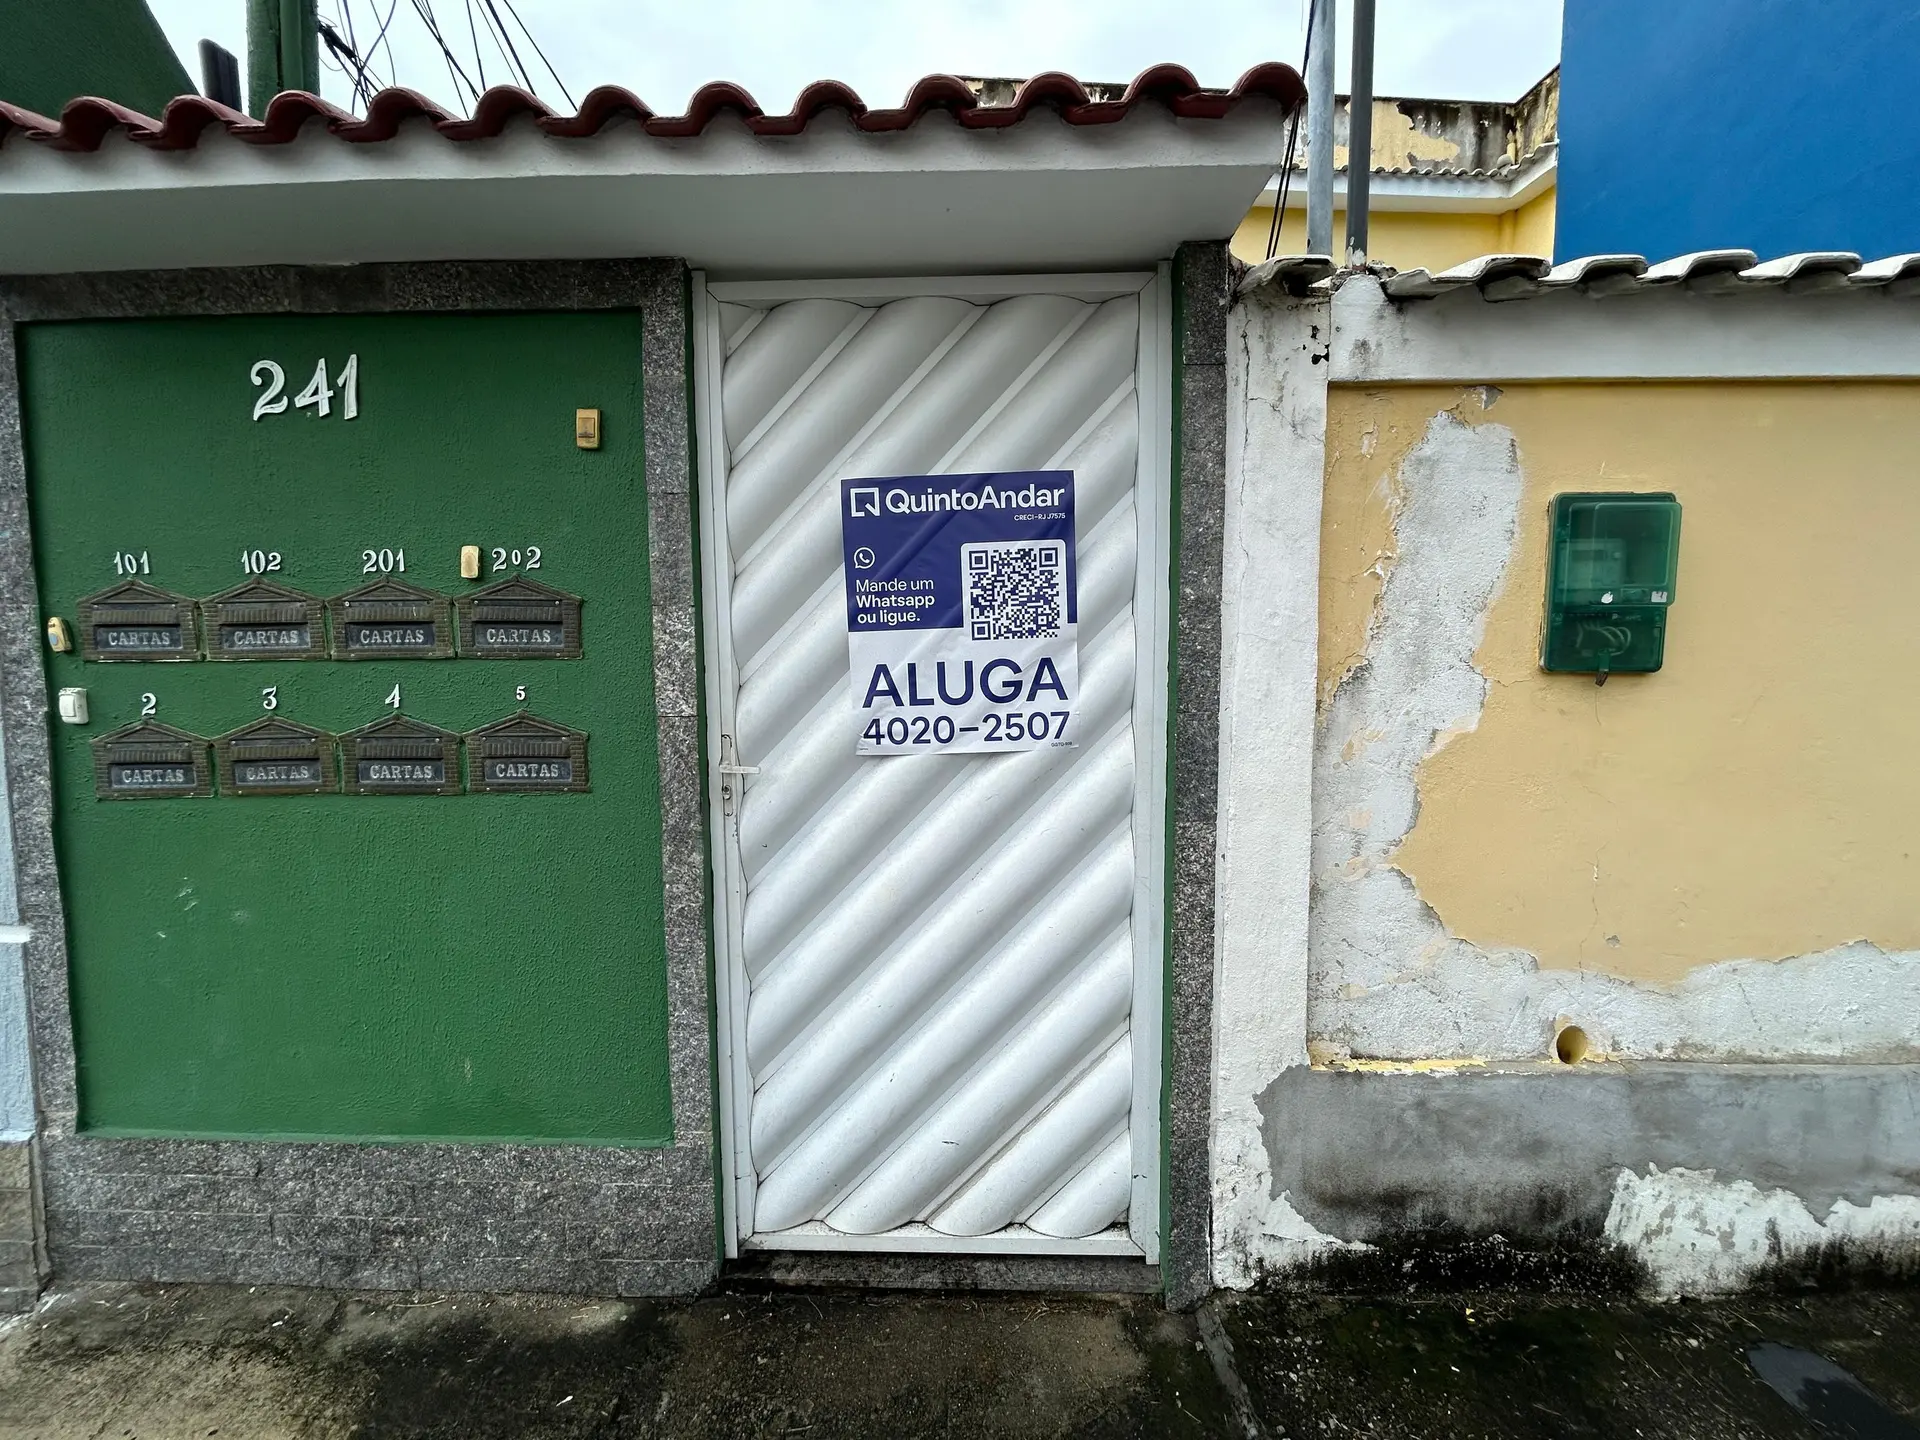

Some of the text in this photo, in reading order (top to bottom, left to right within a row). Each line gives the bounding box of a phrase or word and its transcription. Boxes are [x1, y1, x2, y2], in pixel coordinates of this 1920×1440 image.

[250, 354, 358, 421] 241
[885, 484, 1065, 514] QuintoAndar
[113, 550, 150, 575] 101
[240, 550, 282, 574] 102
[362, 548, 405, 574] 201
[492, 546, 542, 572] 202
[856, 579, 934, 593] Mande um
[856, 594, 935, 609] Whatsapp
[857, 610, 920, 626] ou ligue.
[108, 631, 170, 646] CARTAS
[234, 630, 298, 645] CARTAS
[360, 629, 424, 643] CARTAS
[486, 628, 551, 643] CARTAS
[862, 657, 1068, 708] ALUGA
[262, 685, 278, 710] 3
[384, 683, 401, 708] 4
[516, 685, 526, 700] 5
[141, 692, 157, 715] 2
[863, 711, 1070, 746] 4020-2507
[121, 769, 184, 783] CARTAS
[246, 765, 309, 781] CARTAS
[369, 764, 433, 779] CARTAS
[495, 763, 559, 777] CARTAS
